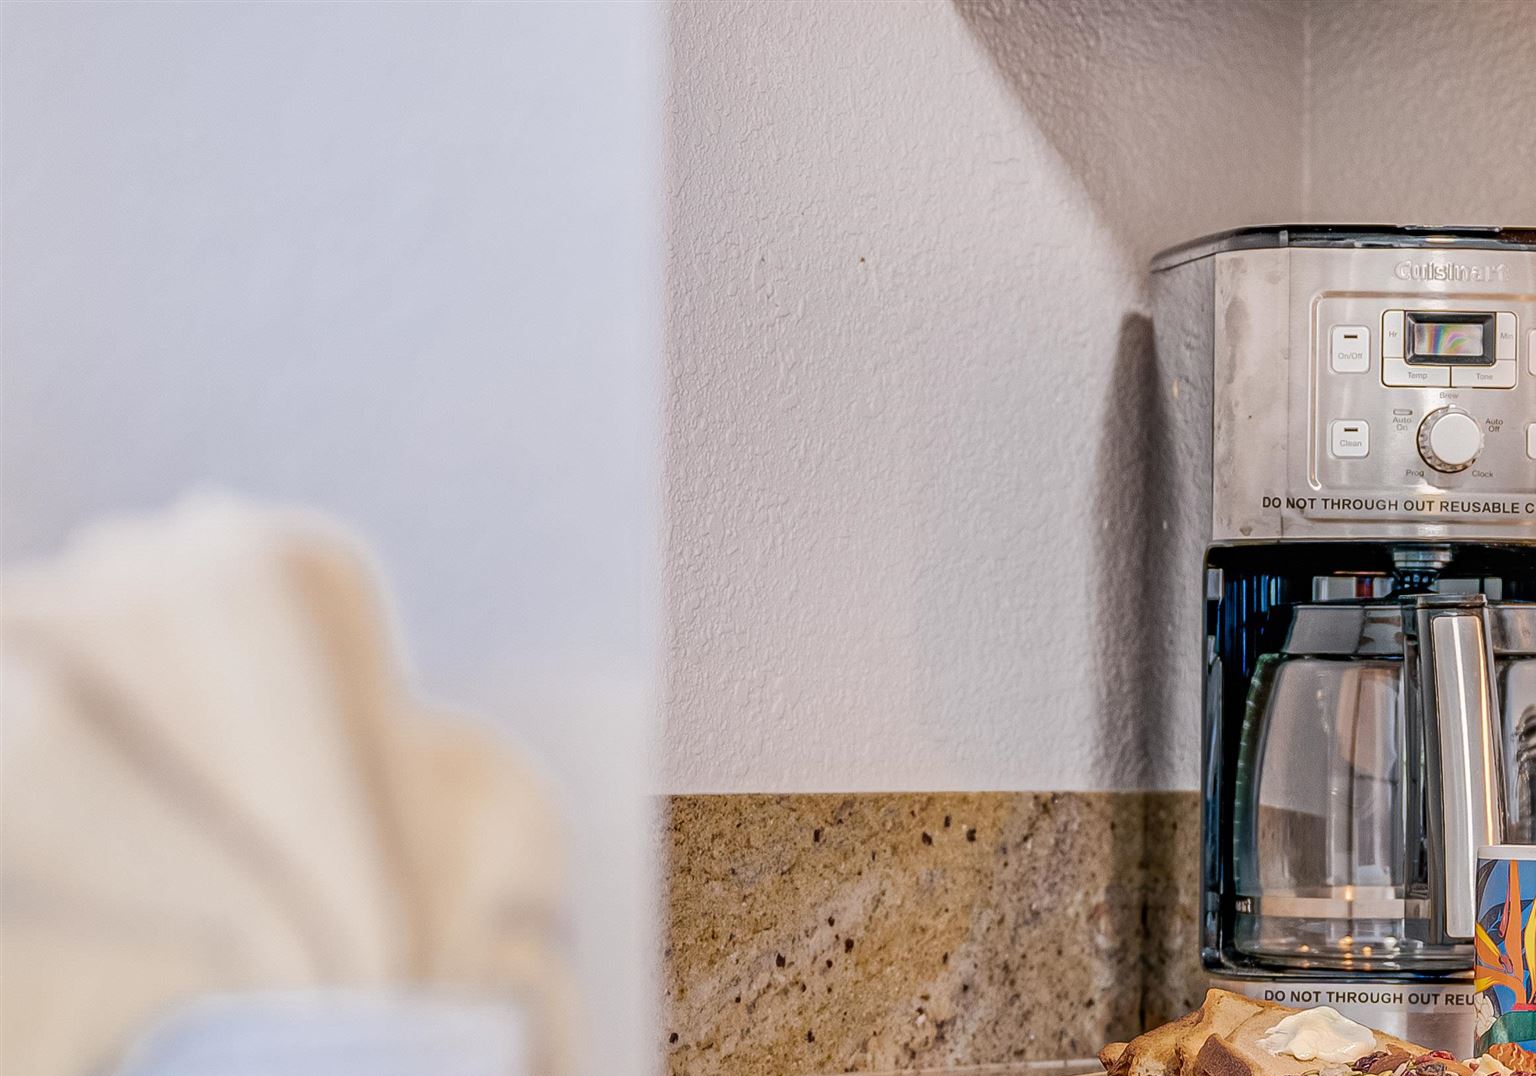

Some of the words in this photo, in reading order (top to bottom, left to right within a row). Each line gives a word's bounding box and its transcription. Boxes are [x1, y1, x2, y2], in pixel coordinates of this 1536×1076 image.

[1394, 260, 1508, 281] Cuisinart
[1388, 330, 1398, 338] Hr
[1500, 332, 1513, 340] Min
[1338, 352, 1362, 361] On/Off
[1408, 372, 1428, 380] Temp
[1476, 373, 1493, 381] Tone
[1393, 416, 1412, 424] Auto
[1485, 418, 1504, 426] Auto
[1396, 424, 1408, 432] On
[1488, 425, 1500, 433] Off
[1340, 440, 1362, 448] Clean
[1405, 469, 1425, 478] Prog
[1471, 470, 1494, 478] Clock
[1262, 496, 1281, 509] DO
[1286, 497, 1317, 510] NOT
[1321, 498, 1398, 511] THROUGH
[1404, 500, 1435, 512] OUT
[1440, 501, 1520, 514] REUSABLE
[1264, 990, 1285, 1002] DO
[1290, 991, 1321, 1003] NOT
[1326, 991, 1403, 1005] THROUGH
[1408, 993, 1440, 1005] OUT
